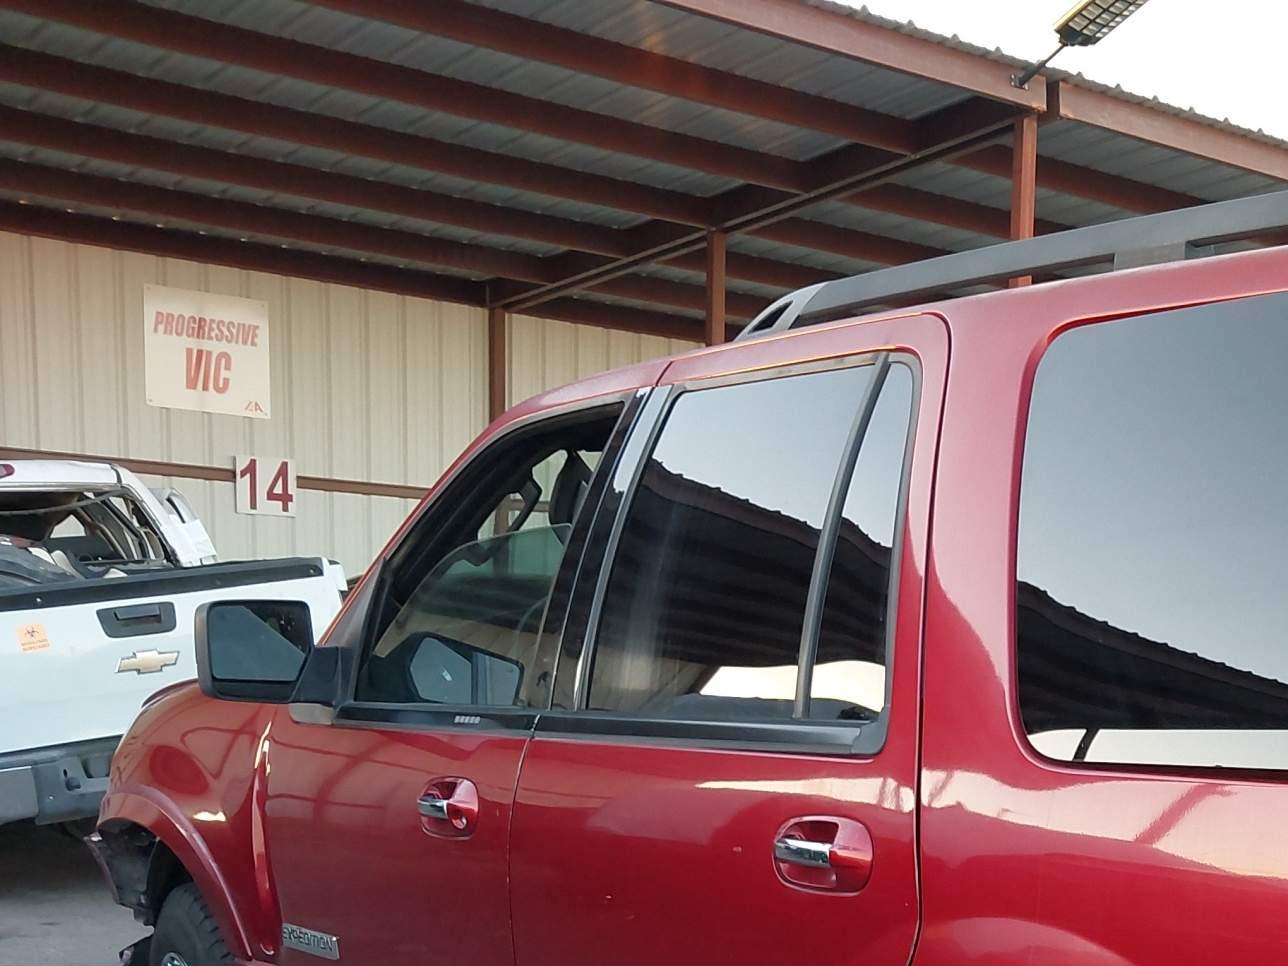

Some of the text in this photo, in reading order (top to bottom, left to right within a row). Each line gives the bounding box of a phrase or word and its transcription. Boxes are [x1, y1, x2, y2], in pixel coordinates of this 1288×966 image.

[153, 311, 260, 347] PROGRESSIVE
[185, 347, 232, 393] VIC
[239, 458, 294, 513] 14
[283, 926, 335, 952] EXPEDITION
